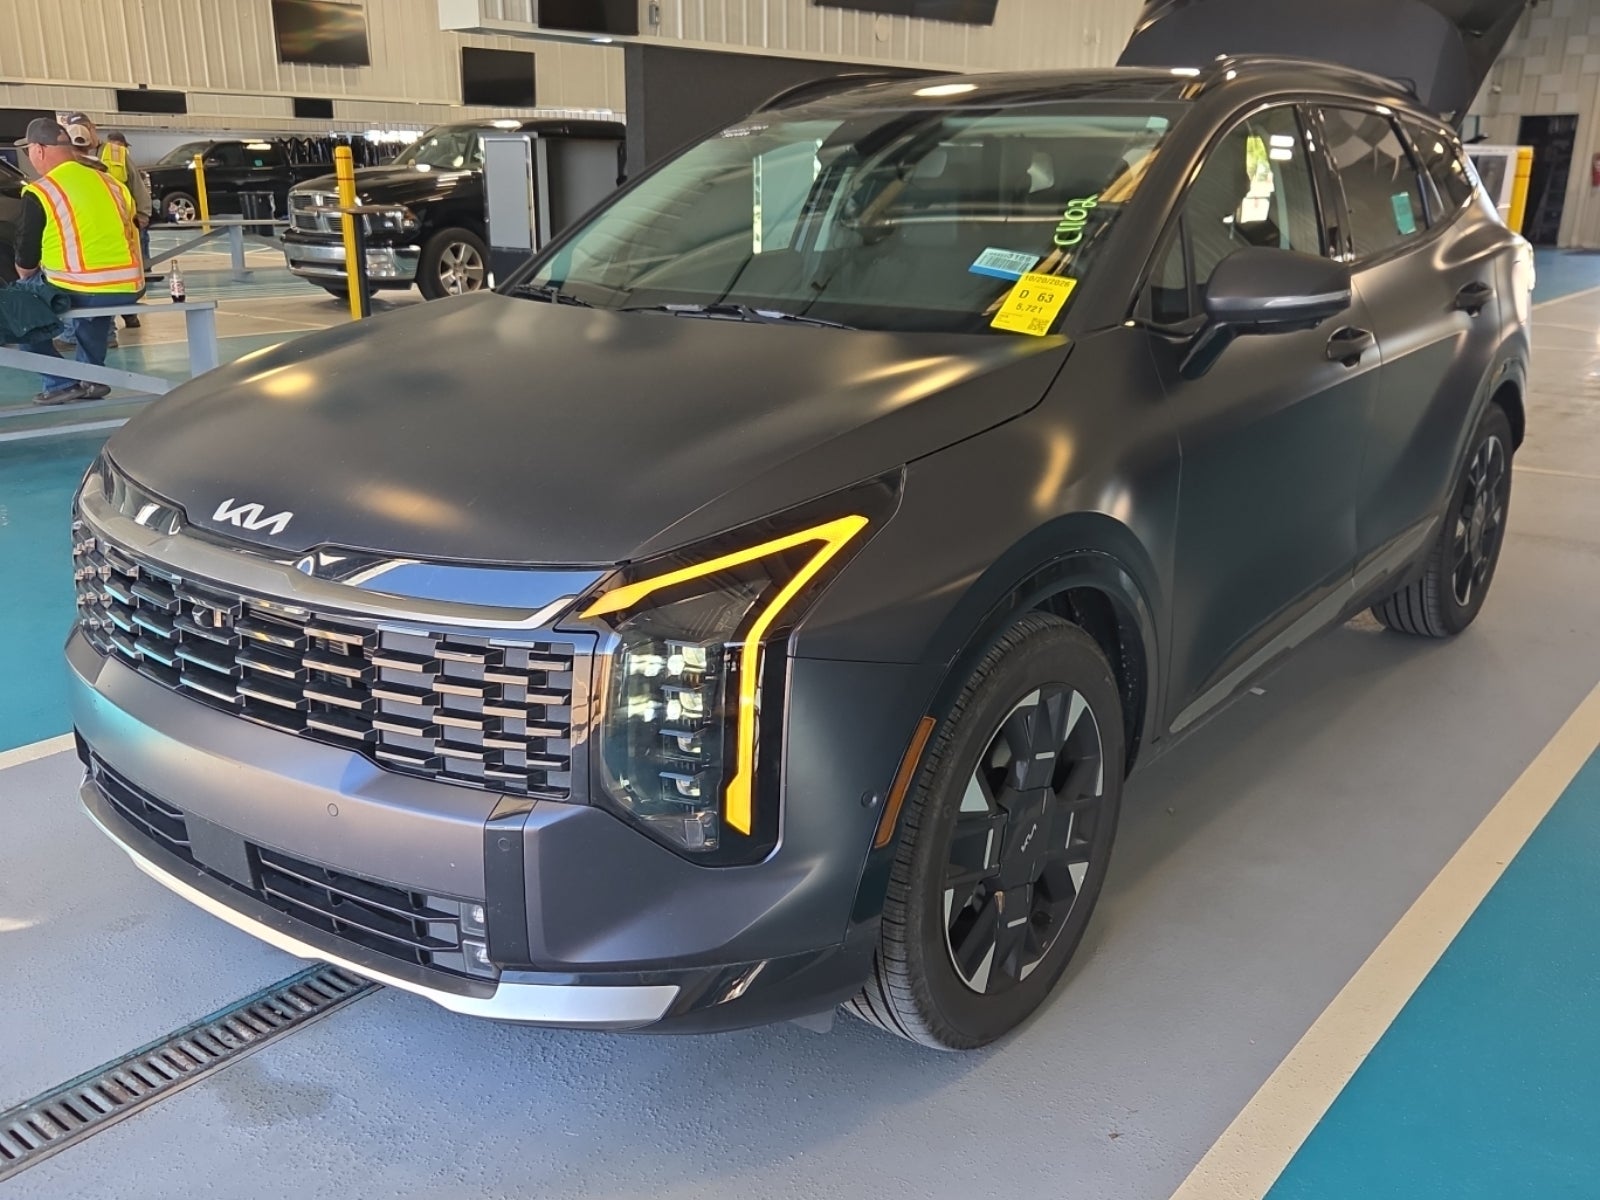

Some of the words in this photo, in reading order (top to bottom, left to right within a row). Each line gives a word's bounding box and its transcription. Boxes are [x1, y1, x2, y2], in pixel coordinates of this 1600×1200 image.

[1018, 289, 1030, 299] D
[1037, 292, 1055, 304] 63
[212, 498, 294, 535] KIA
